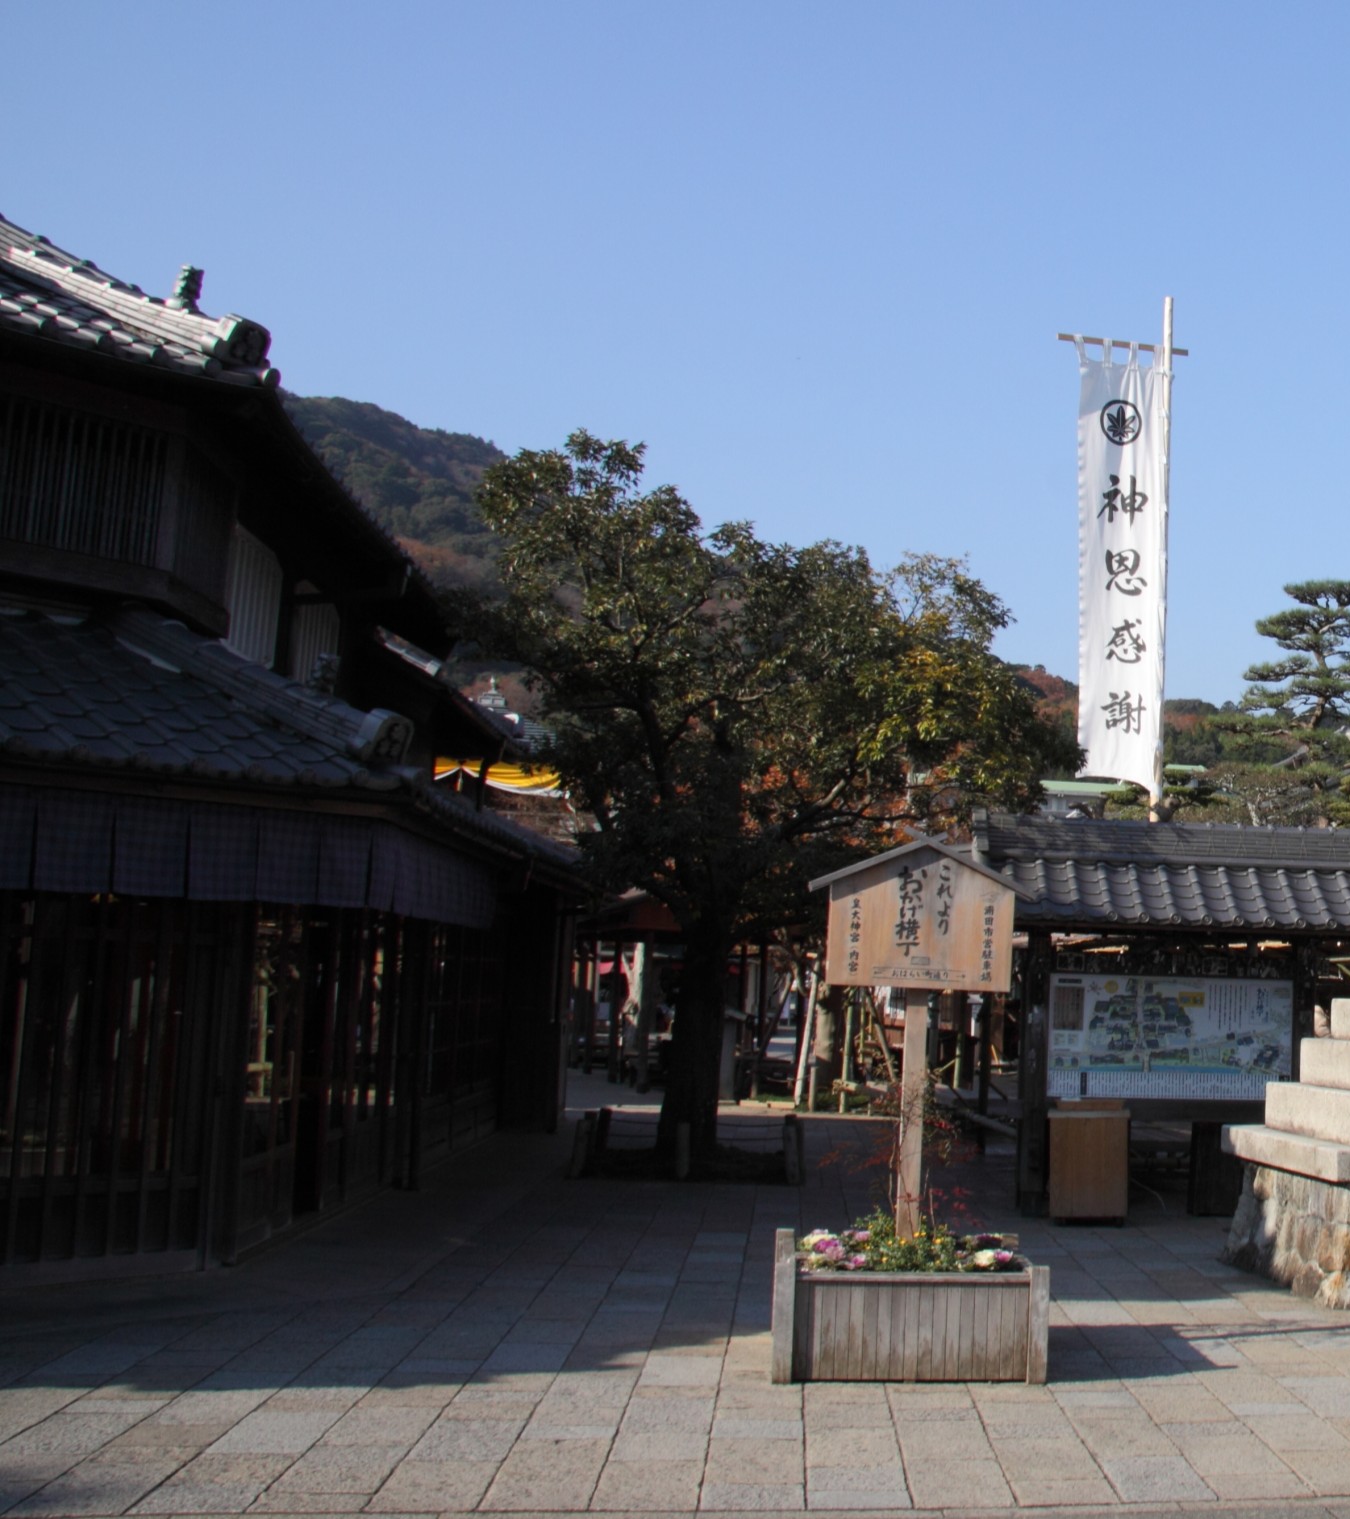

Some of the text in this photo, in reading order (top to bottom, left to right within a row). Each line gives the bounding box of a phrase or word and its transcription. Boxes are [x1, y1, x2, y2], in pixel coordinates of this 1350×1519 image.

[1097, 473, 1149, 737] 神恩感謝
[895, 865, 927, 957] おかげ横丁
[936, 864, 953, 936] これより
